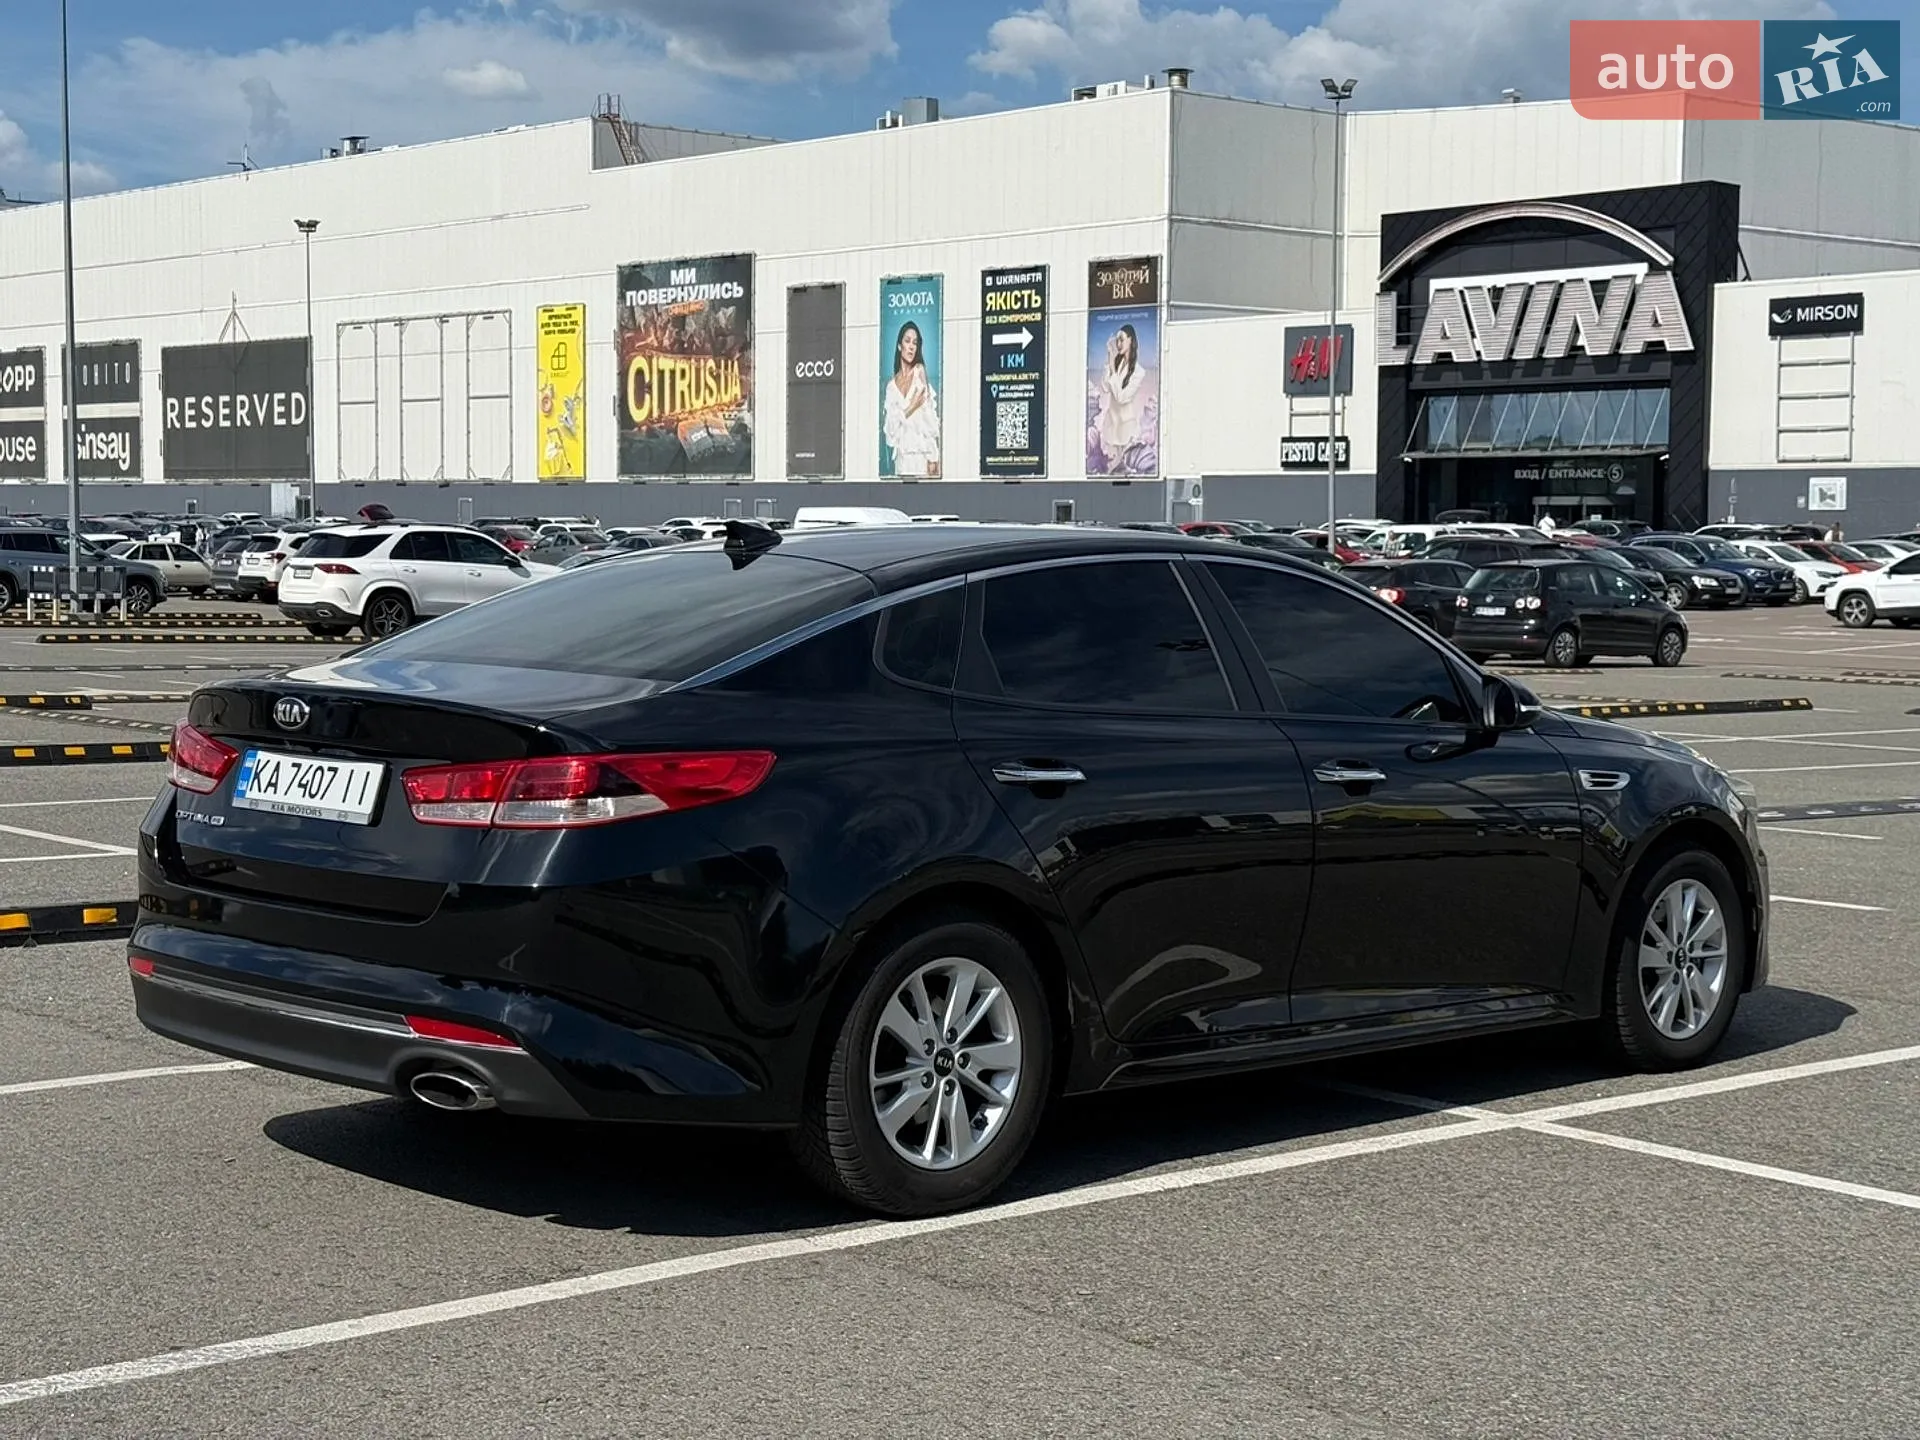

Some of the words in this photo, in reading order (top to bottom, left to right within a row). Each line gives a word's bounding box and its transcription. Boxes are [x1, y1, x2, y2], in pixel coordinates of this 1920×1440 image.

[670, 267, 697, 286] МИ
[625, 281, 744, 307] ПОВЕРНУЛИСЬ
[888, 291, 935, 308] ЗОЛОТА
[986, 289, 1042, 312] ЯКІСТЬ
[1112, 282, 1134, 300] ВІК
[1376, 271, 1693, 366] LAVINA
[1796, 304, 1859, 323] MIRSON
[795, 359, 835, 378] ecco
[1000, 354, 1005, 369] 1
[0, 364, 36, 394] OPP
[627, 355, 741, 424] CITRUS.UA
[166, 391, 307, 430] RESERVED
[1281, 441, 1316, 462] PESTO
[1514, 469, 1540, 481] ВХІД
[1548, 468, 1604, 479] ENTRANCE
[277, 702, 302, 723] KIA
[284, 762, 339, 801] 7407
[270, 802, 286, 813] KIA
[287, 804, 323, 818] MOTORS
